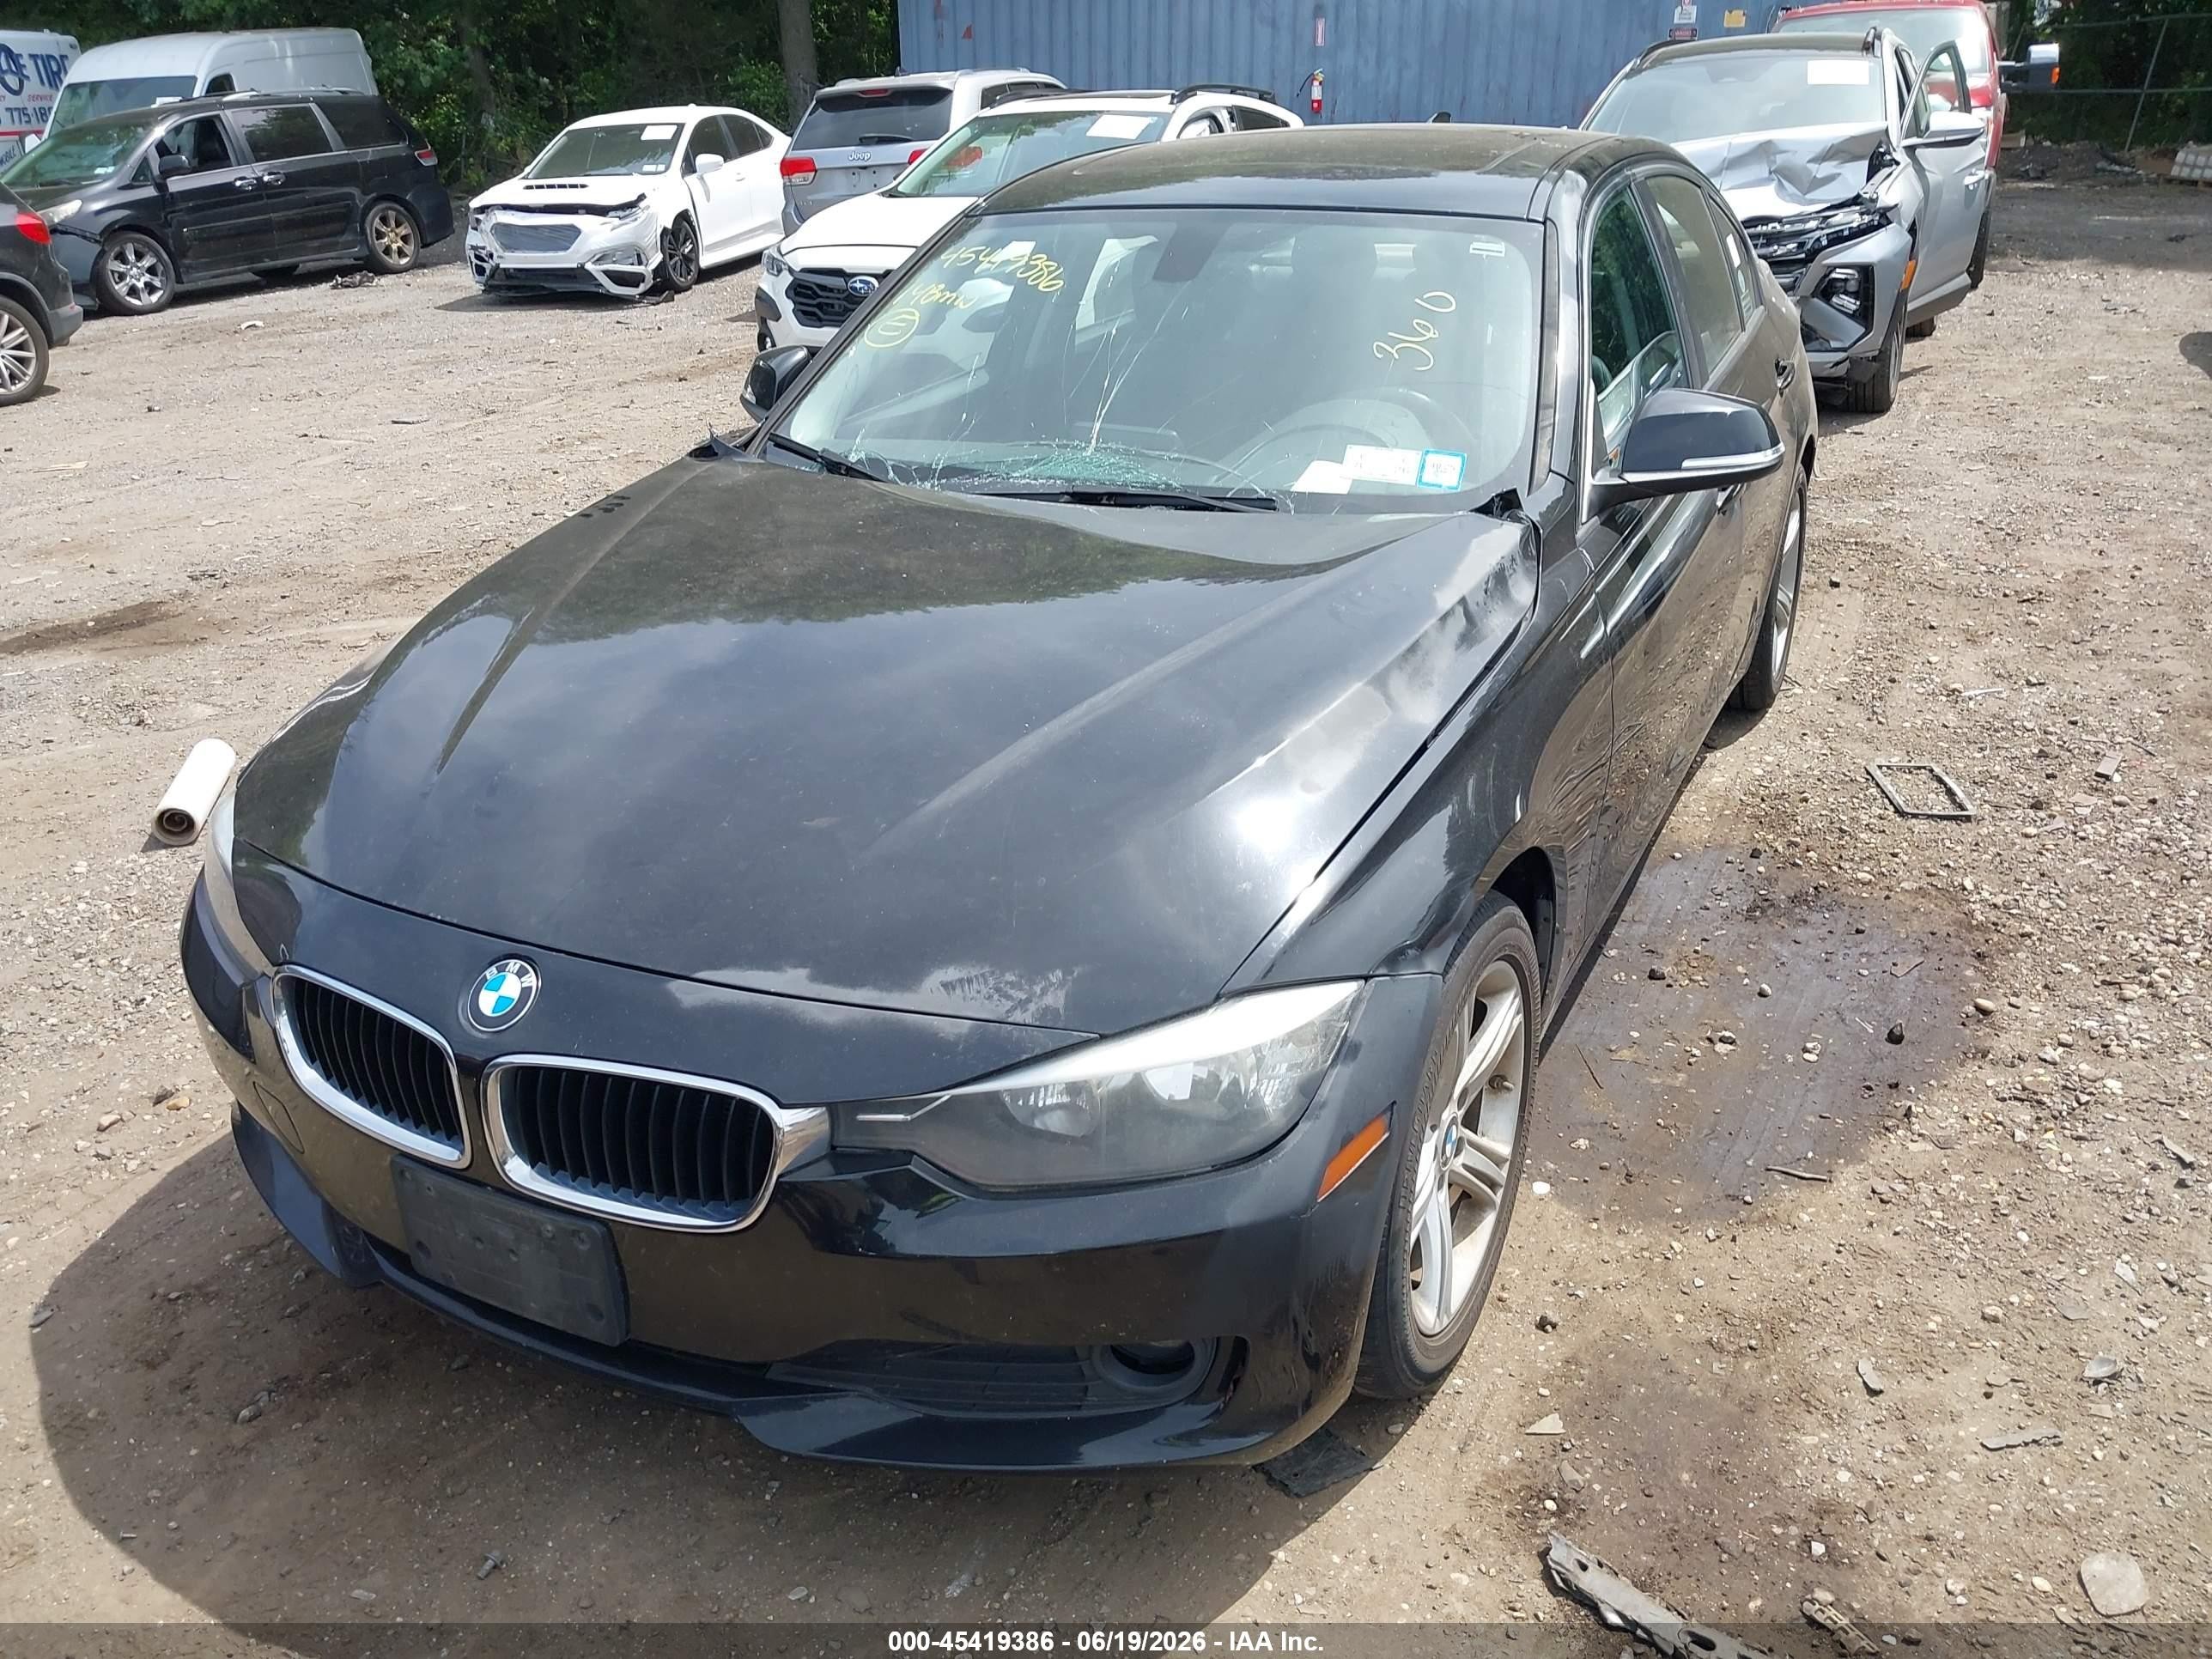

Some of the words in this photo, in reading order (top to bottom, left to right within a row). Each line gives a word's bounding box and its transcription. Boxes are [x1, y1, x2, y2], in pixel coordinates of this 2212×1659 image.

[848, 150, 871, 162] Jeep
[1373, 290, 1457, 371] 360
[484, 961, 534, 988] BMW
